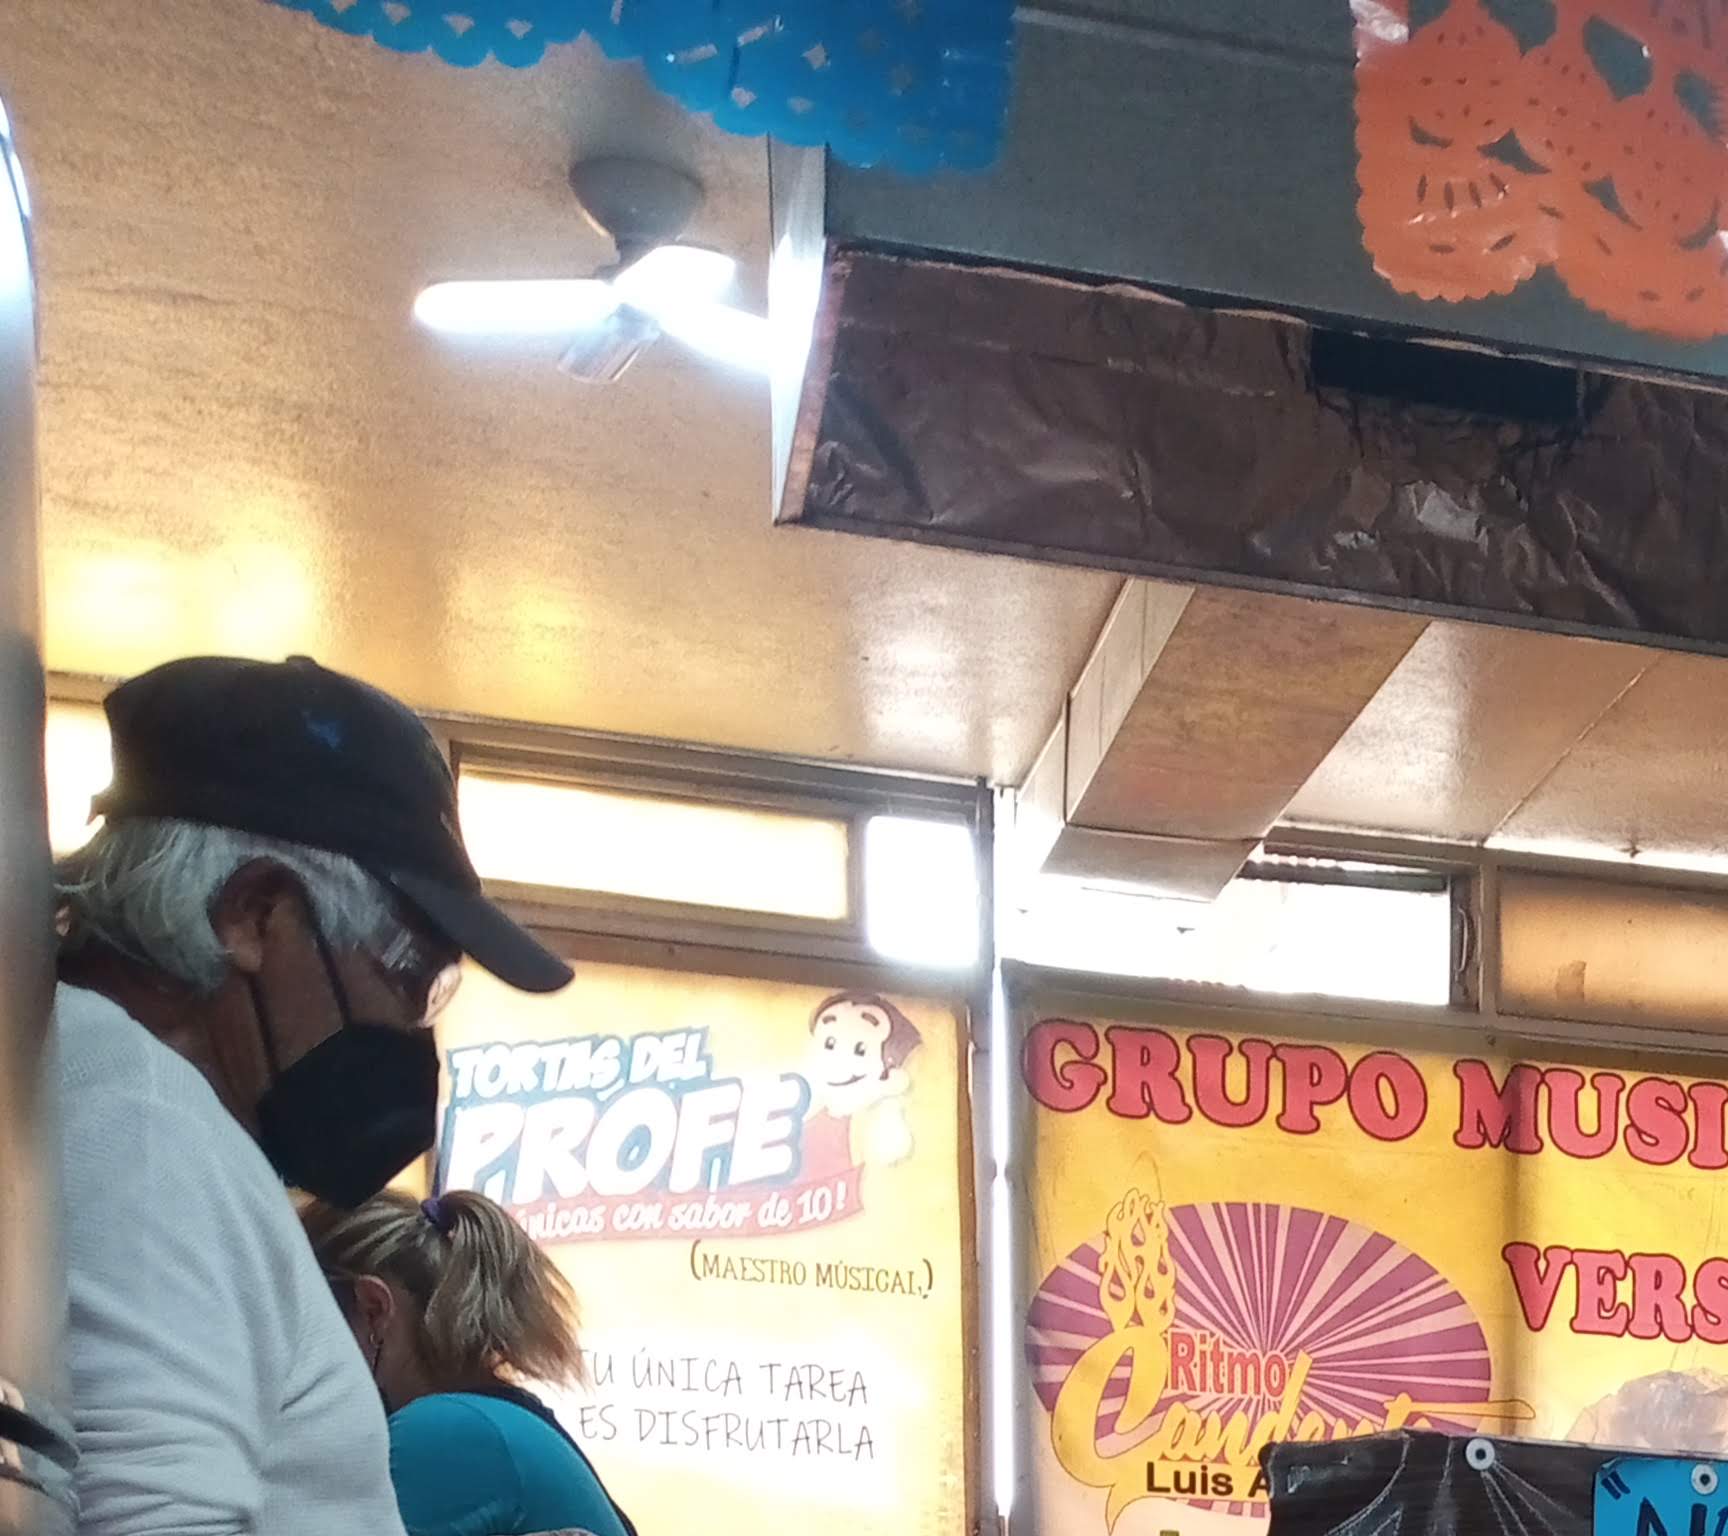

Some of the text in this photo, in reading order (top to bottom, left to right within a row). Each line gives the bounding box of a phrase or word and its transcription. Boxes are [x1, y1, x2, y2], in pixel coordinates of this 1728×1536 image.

[450, 1026, 710, 1100] TORTAS DEL
[1022, 1018, 1428, 1142] GRUPO
[444, 1074, 806, 1208] PROFE
[612, 1199, 665, 1231] con
[667, 1193, 753, 1230] sabor
[758, 1194, 794, 1228] de
[797, 1184, 848, 1221] 10!
[690, 1239, 807, 1288] (MAESTRO
[632, 1346, 743, 1398] ÚNICA
[759, 1362, 868, 1407] TAREA
[1167, 1330, 1290, 1398] Ritmo
[579, 1403, 875, 1462] ES DISFRUTARLA
[1145, 1461, 1234, 1497] Luis
